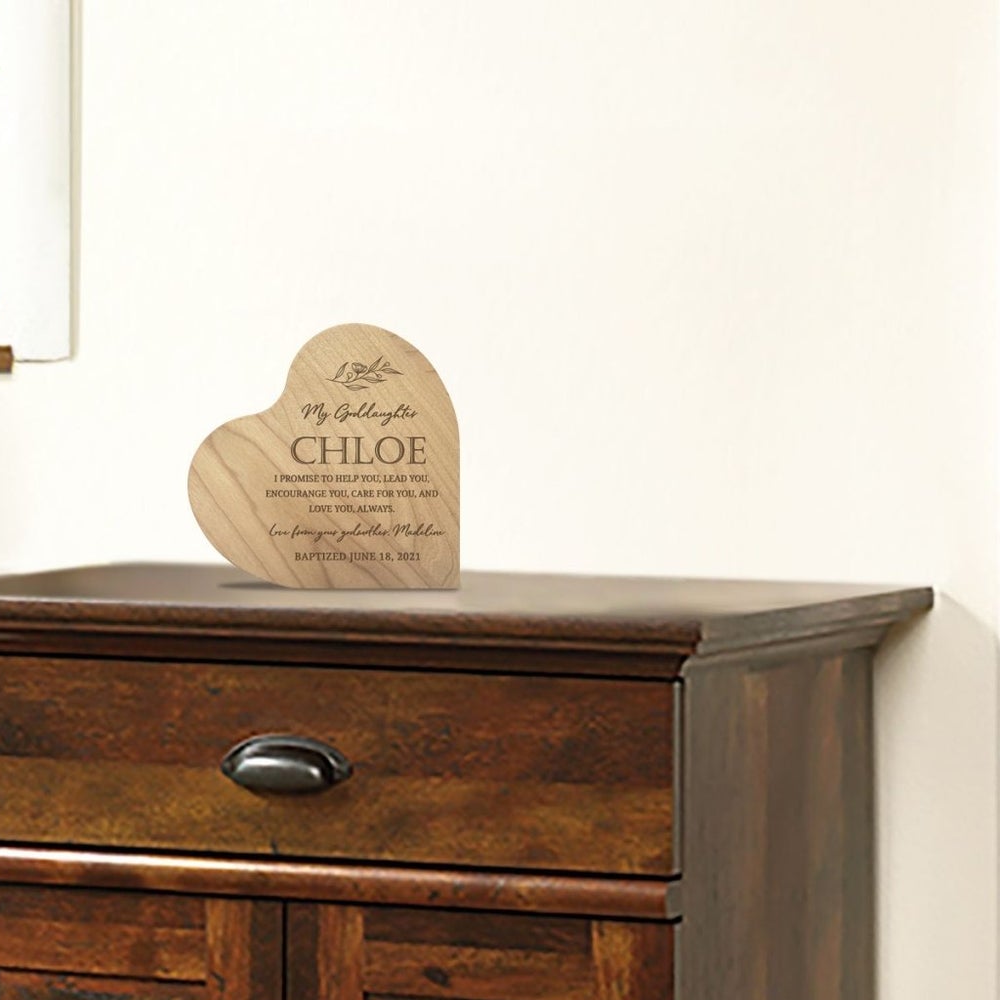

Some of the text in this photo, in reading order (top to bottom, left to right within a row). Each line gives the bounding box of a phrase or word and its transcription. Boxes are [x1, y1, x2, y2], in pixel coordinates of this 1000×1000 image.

[301, 402, 418, 426] My Goddaughter
[290, 436, 426, 465] CHLOE
[274, 474, 430, 484] I PROMISE TO HELP YOU, LEAD YOU,
[265, 489, 439, 499] ENCOURANGE YOU, CARE FOR YOU, AND
[308, 504, 395, 514] LOVE YOU, ALWAYS.
[269, 523, 290, 536] Love
[290, 524, 315, 539] from
[314, 529, 337, 543] your
[393, 522, 445, 537] Madeline
[295, 552, 420, 563] BAPTIZED JUNE 18, 2021
